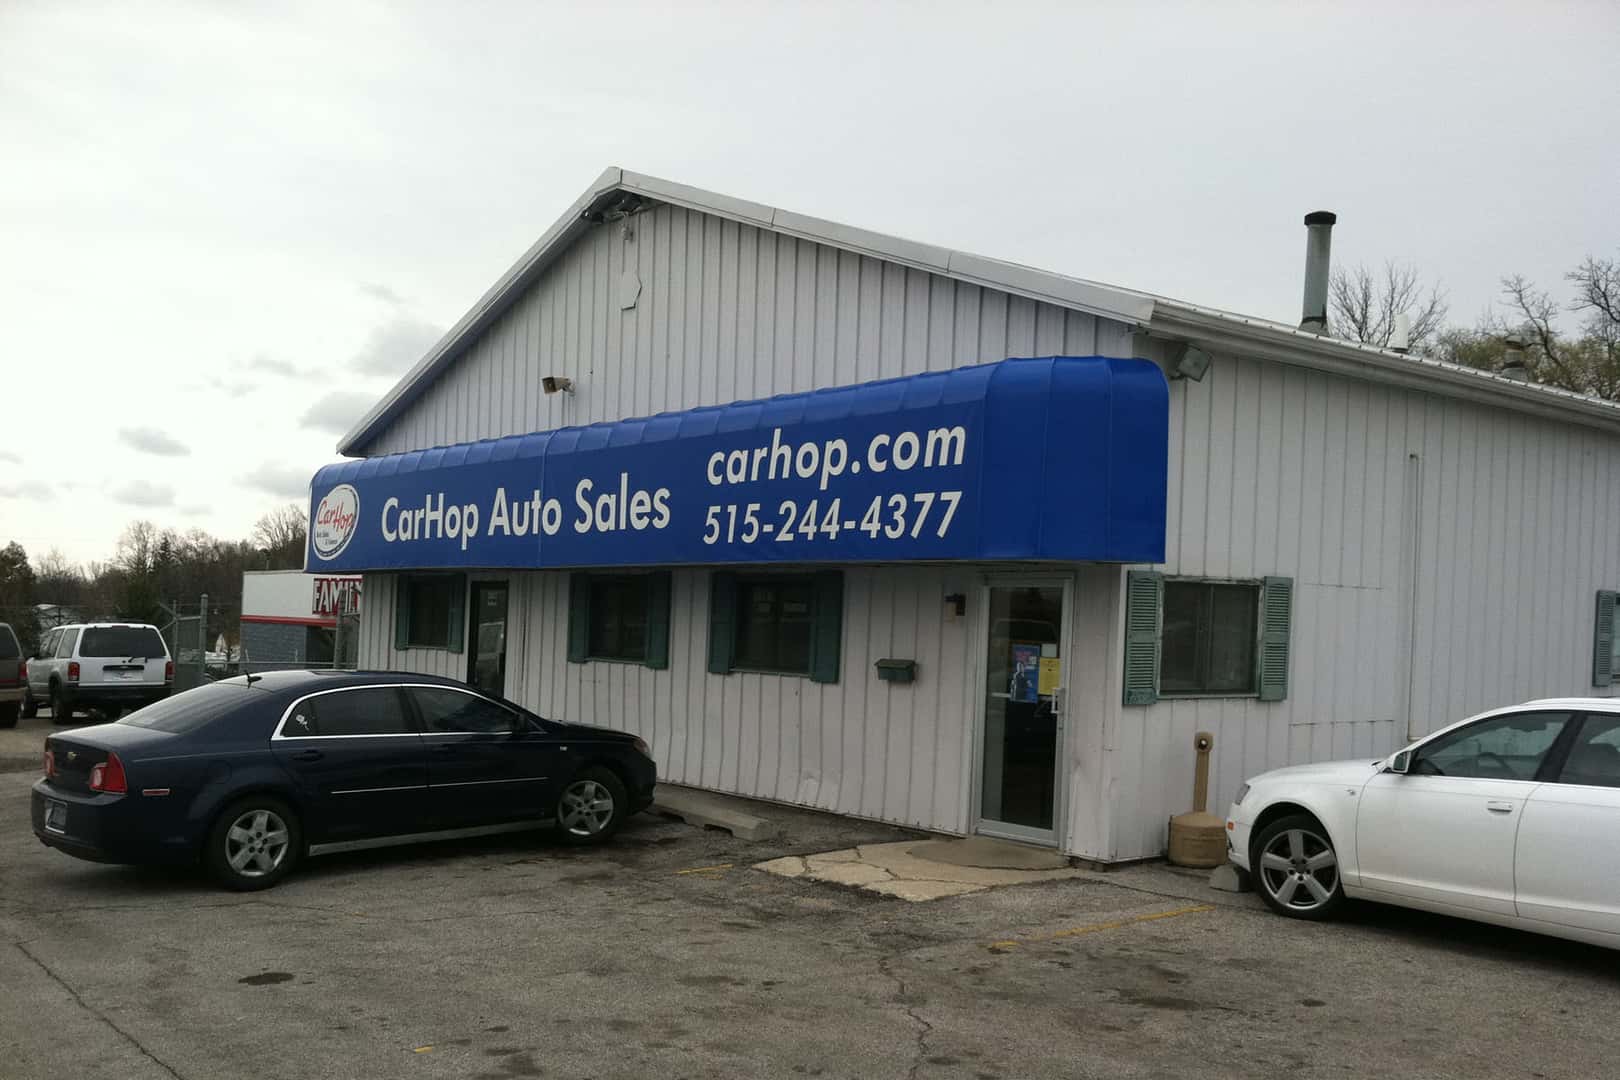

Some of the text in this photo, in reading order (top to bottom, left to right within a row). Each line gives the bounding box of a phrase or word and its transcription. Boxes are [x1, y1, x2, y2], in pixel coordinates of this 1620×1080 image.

[707, 426, 966, 491] carhop.com
[317, 500, 354, 534] CarHop
[381, 472, 671, 551] CarHop Auto Sales
[703, 490, 963, 545] 515-244-4377
